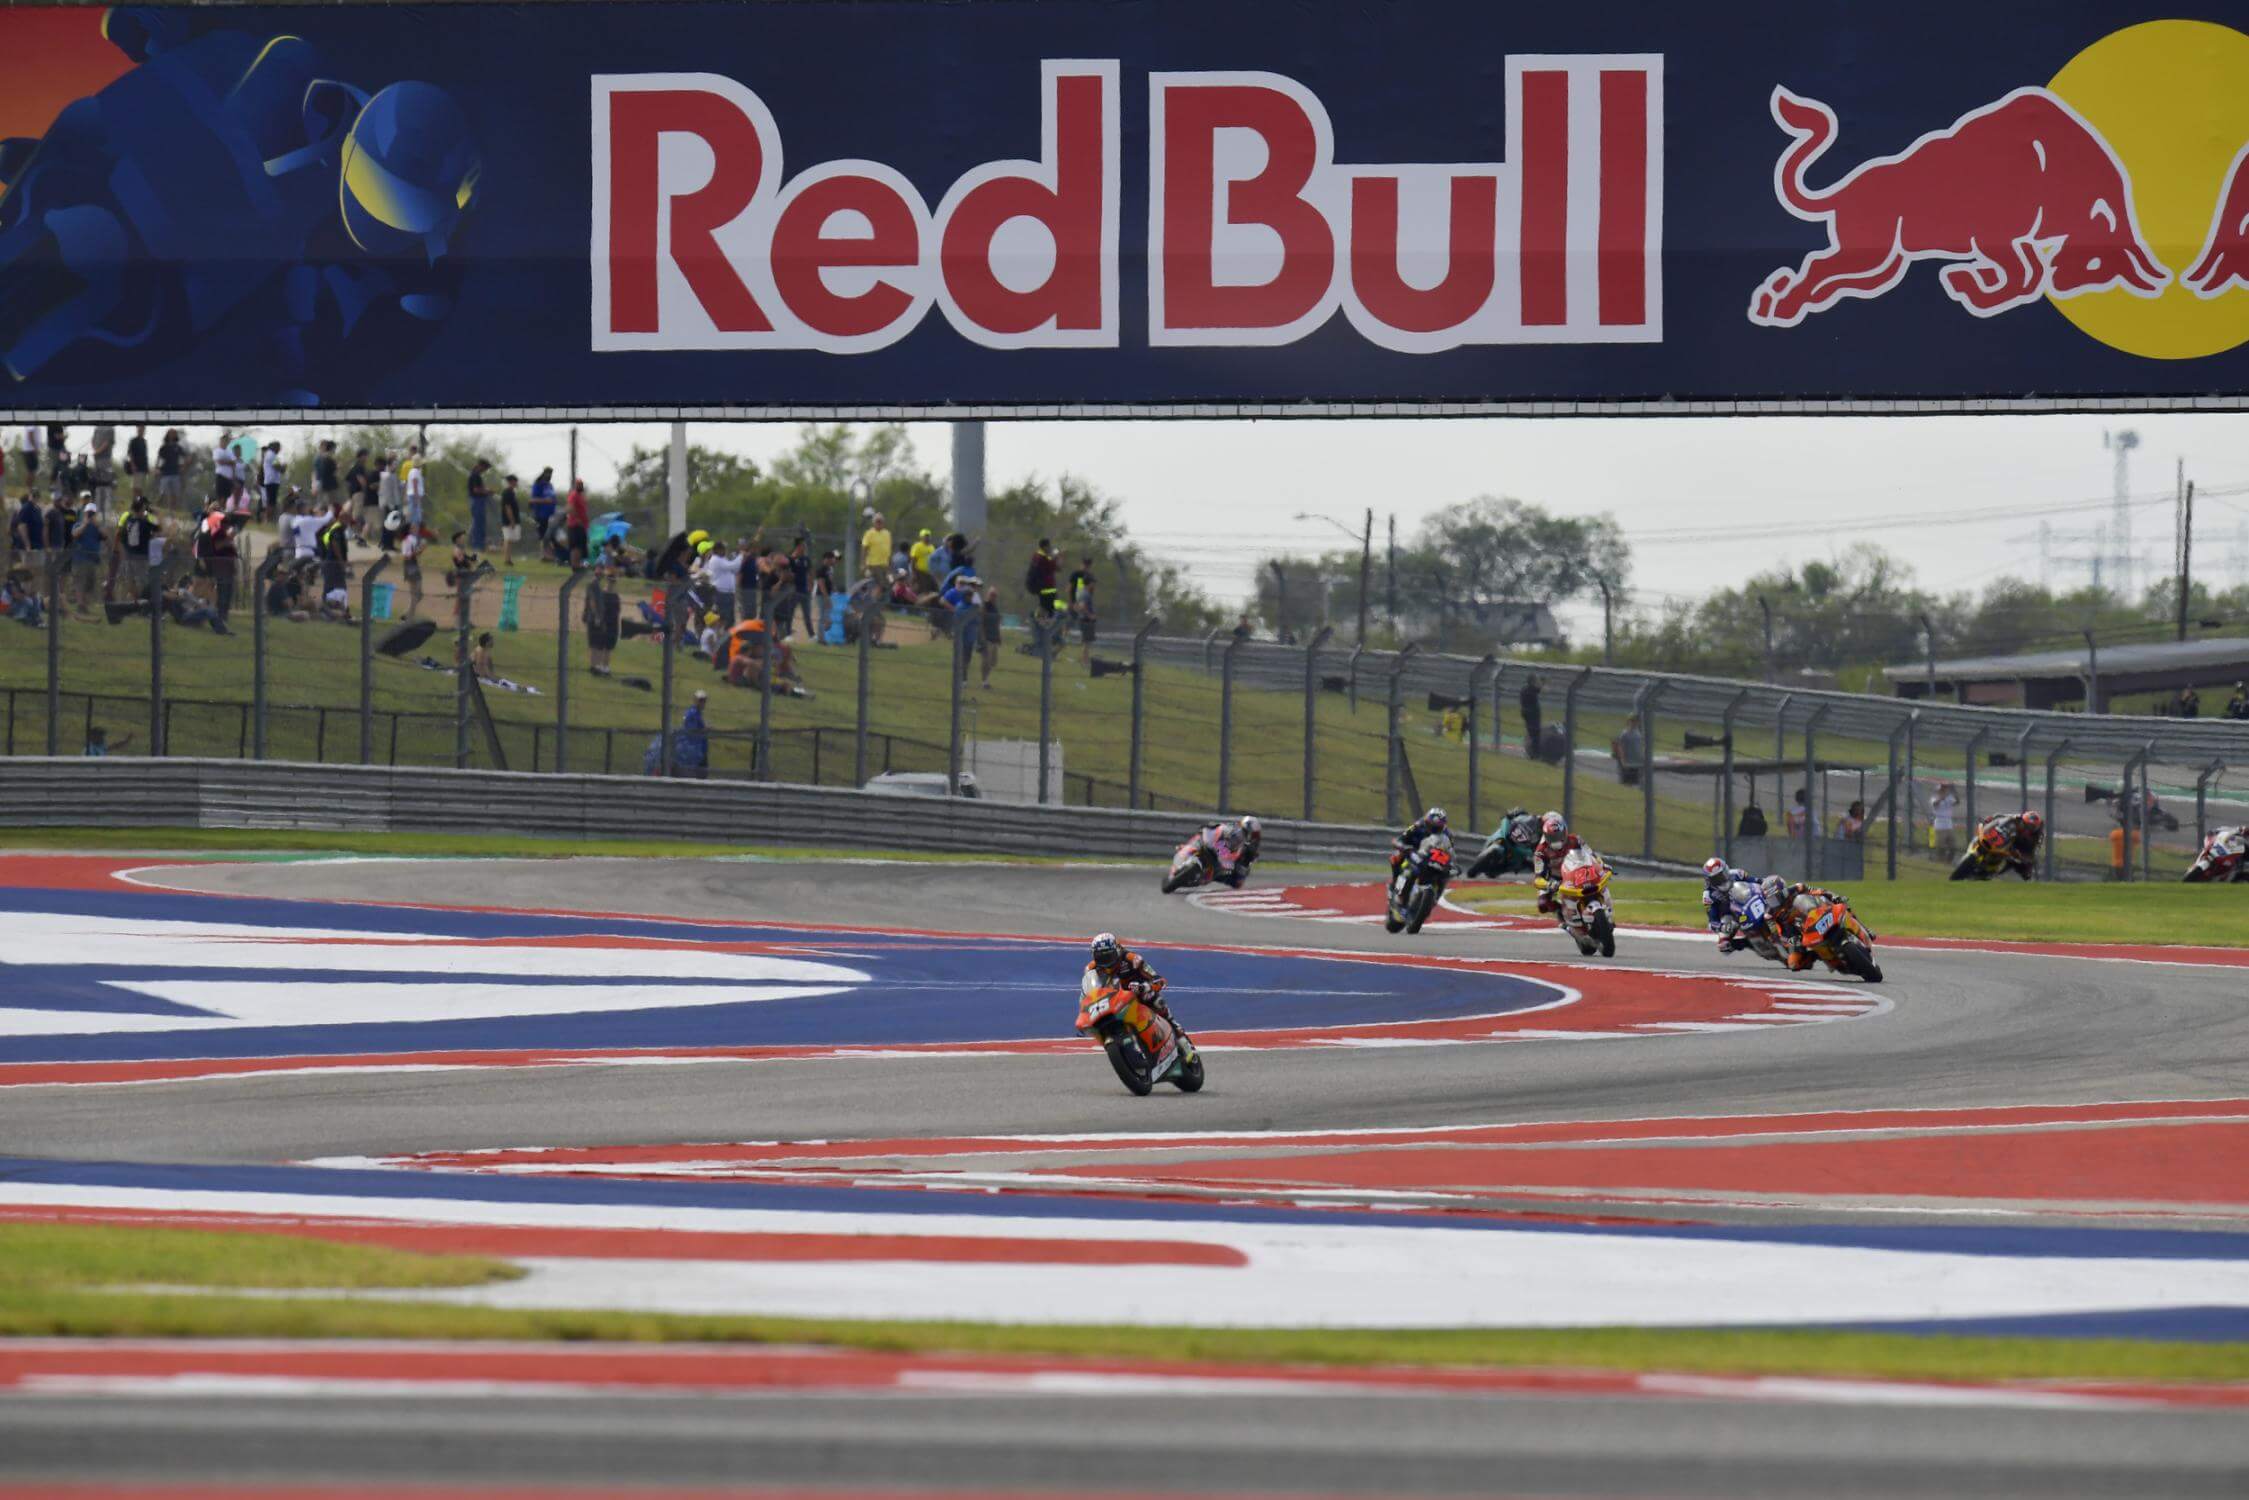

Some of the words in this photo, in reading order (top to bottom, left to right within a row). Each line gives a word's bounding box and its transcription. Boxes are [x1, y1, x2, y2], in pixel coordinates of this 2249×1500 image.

[591, 59, 1120, 353] Red
[1148, 53, 1663, 353] Bull
[1574, 865, 1597, 886] 21
